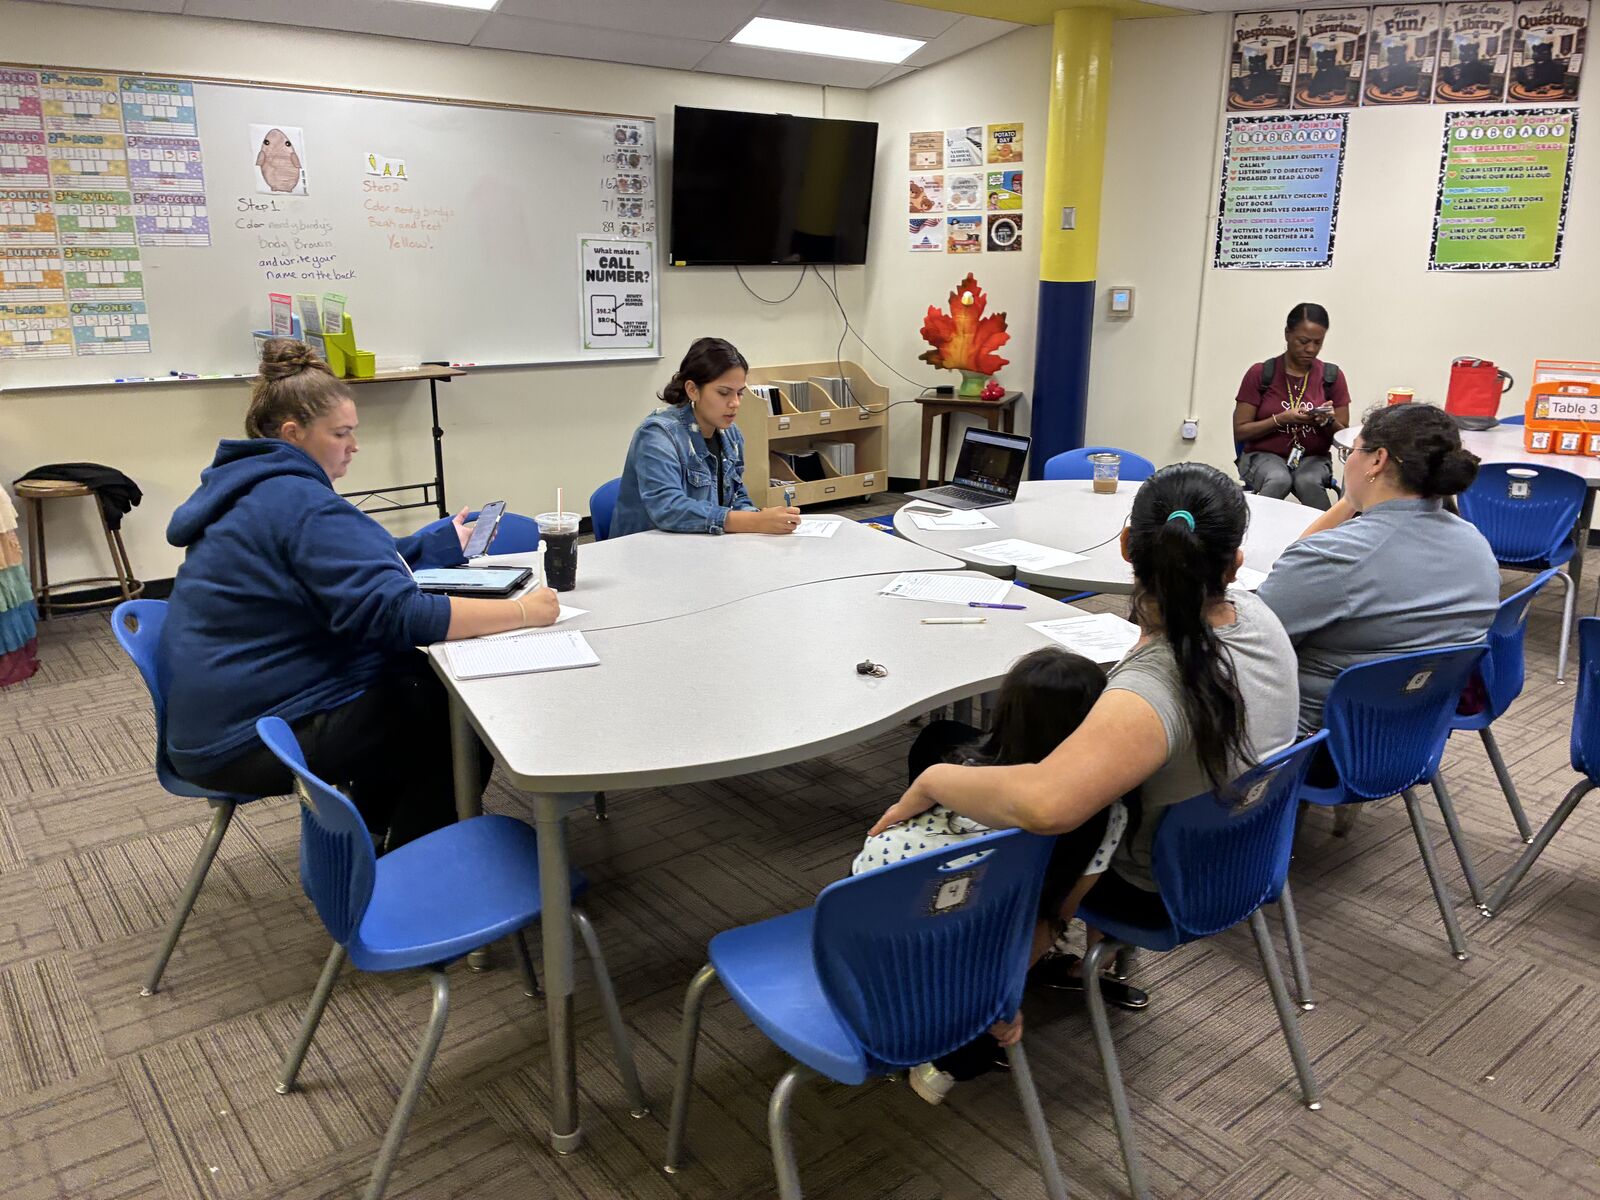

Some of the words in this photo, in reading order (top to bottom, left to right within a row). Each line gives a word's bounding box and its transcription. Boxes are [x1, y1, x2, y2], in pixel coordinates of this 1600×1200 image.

[1259, 14, 1273, 27] Be
[1384, 16, 1427, 35] Fun!
[1453, 18, 1504, 33] Library
[1518, 13, 1586, 29] Questions
[1236, 26, 1296, 42] Responsible
[1239, 130, 1335, 143] LIBRARY
[1457, 125, 1563, 139] LIBRARY
[237, 198, 269, 212] Step
[271, 200, 280, 212] 1
[294, 238, 332, 250] Brown
[259, 257, 278, 267] and
[312, 254, 336, 268] your
[599, 256, 635, 269] CALL
[266, 271, 297, 279] name
[301, 271, 314, 279] on
[315, 270, 332, 280] the
[333, 269, 356, 280] back
[586, 269, 650, 283] NUMBER?
[1552, 402, 1586, 414] Table
[1589, 404, 1598, 414] 3
